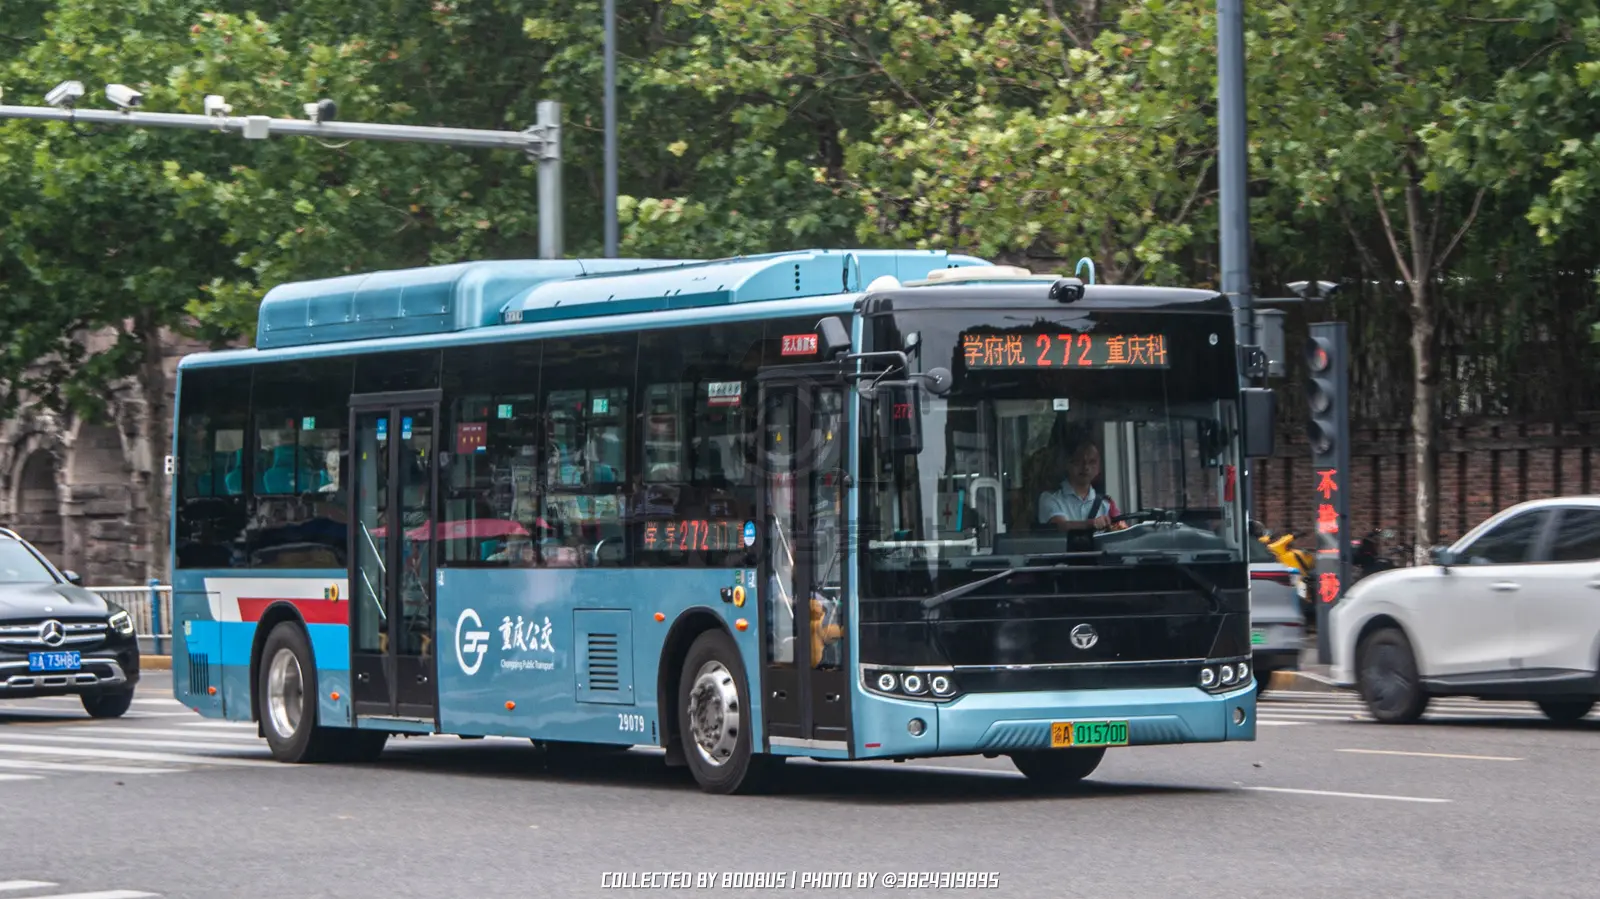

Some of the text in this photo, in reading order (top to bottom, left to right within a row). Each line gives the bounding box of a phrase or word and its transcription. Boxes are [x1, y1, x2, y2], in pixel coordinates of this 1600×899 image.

[963, 333, 1167, 366] 学府悦 272 重庆科
[680, 519, 709, 550] 272
[498, 615, 555, 653] 重庆公交
[618, 714, 645, 732] 29079
